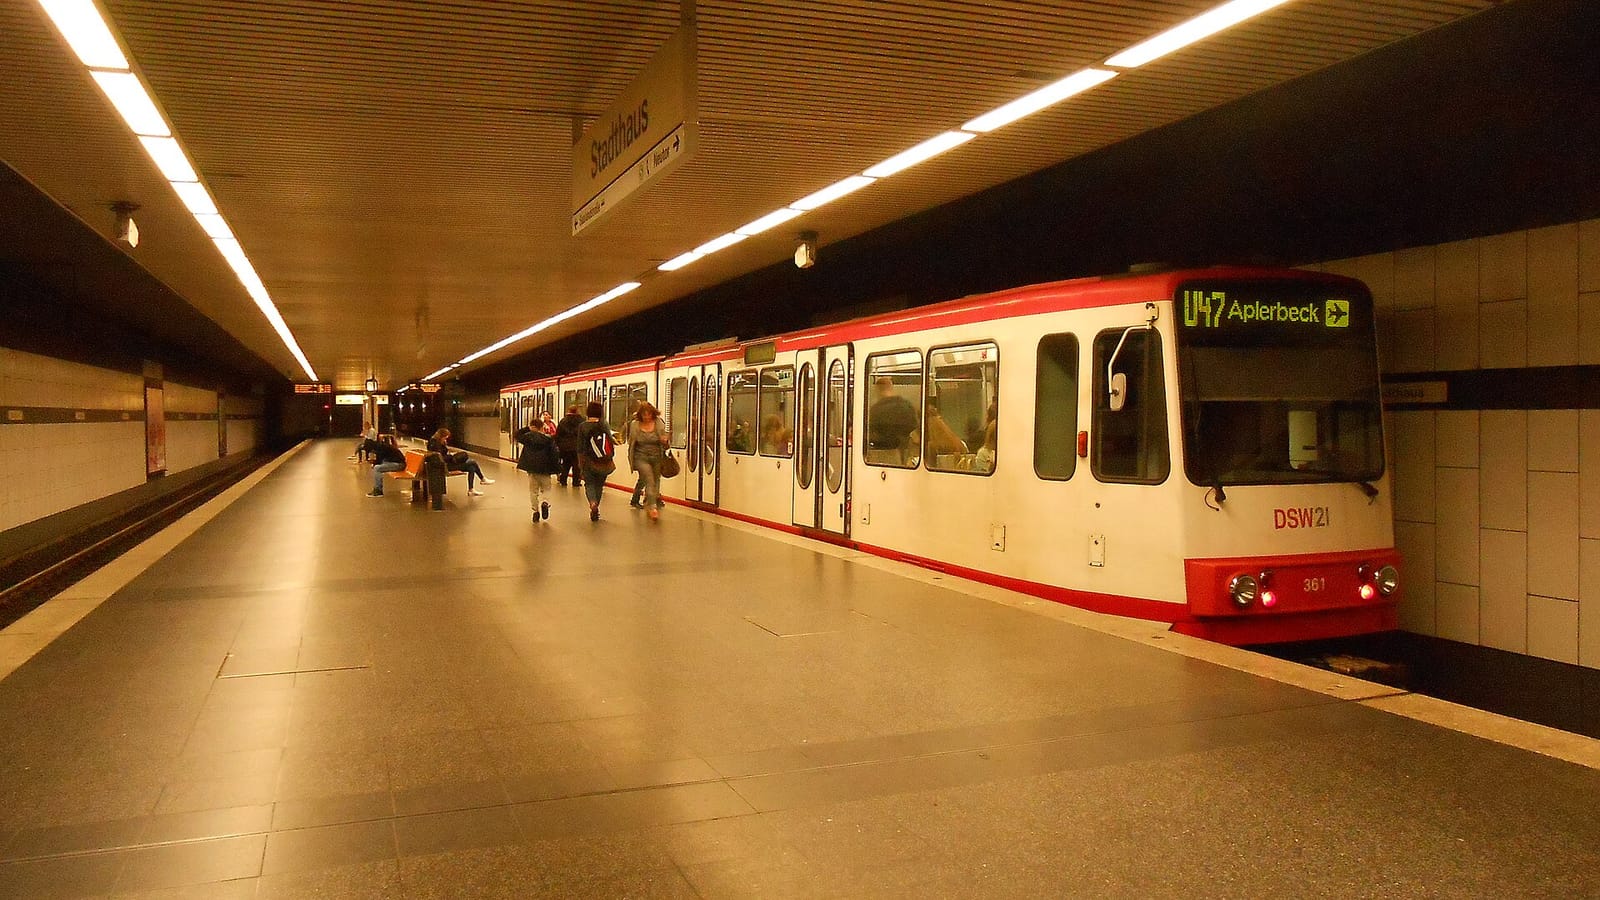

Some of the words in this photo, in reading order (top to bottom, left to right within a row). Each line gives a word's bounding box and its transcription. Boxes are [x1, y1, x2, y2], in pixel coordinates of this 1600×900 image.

[591, 98, 648, 179] Stadthaus
[1184, 290, 1226, 328] U47
[1227, 299, 1320, 323] Aplerbeck
[1273, 506, 1329, 530] DSW21
[1303, 577, 1326, 592] 361
